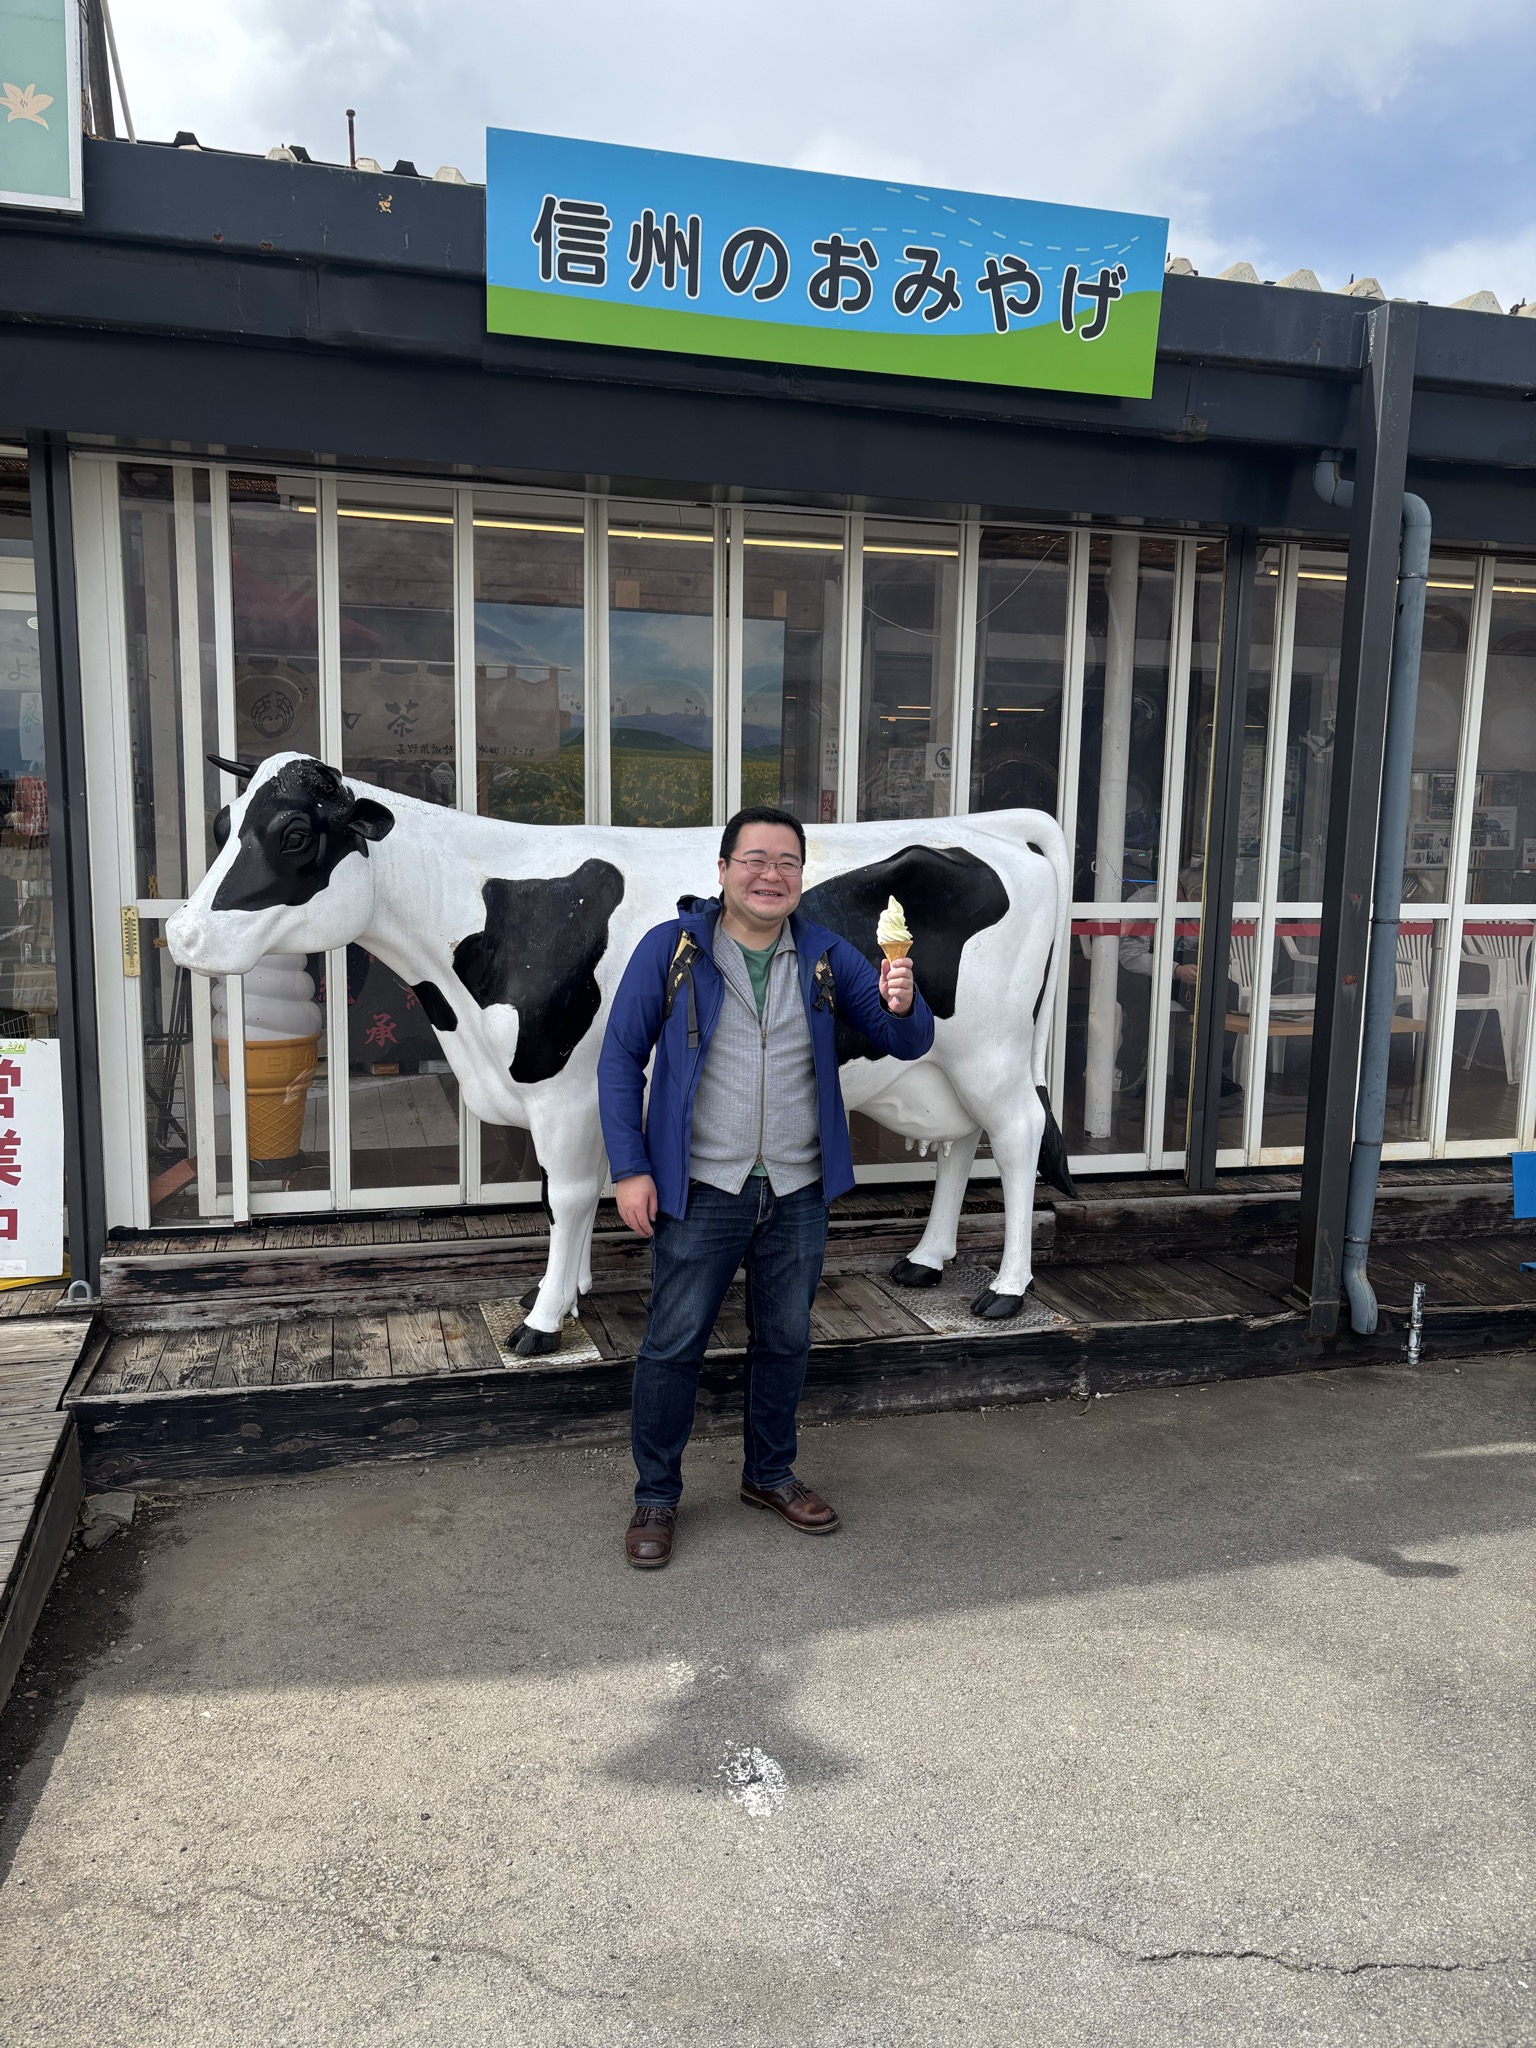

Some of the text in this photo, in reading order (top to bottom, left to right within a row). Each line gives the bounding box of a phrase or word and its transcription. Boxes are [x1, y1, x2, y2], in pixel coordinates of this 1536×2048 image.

[531, 193, 1128, 341] 信州のおみやげ
[822, 790, 832, 823] 消火器
